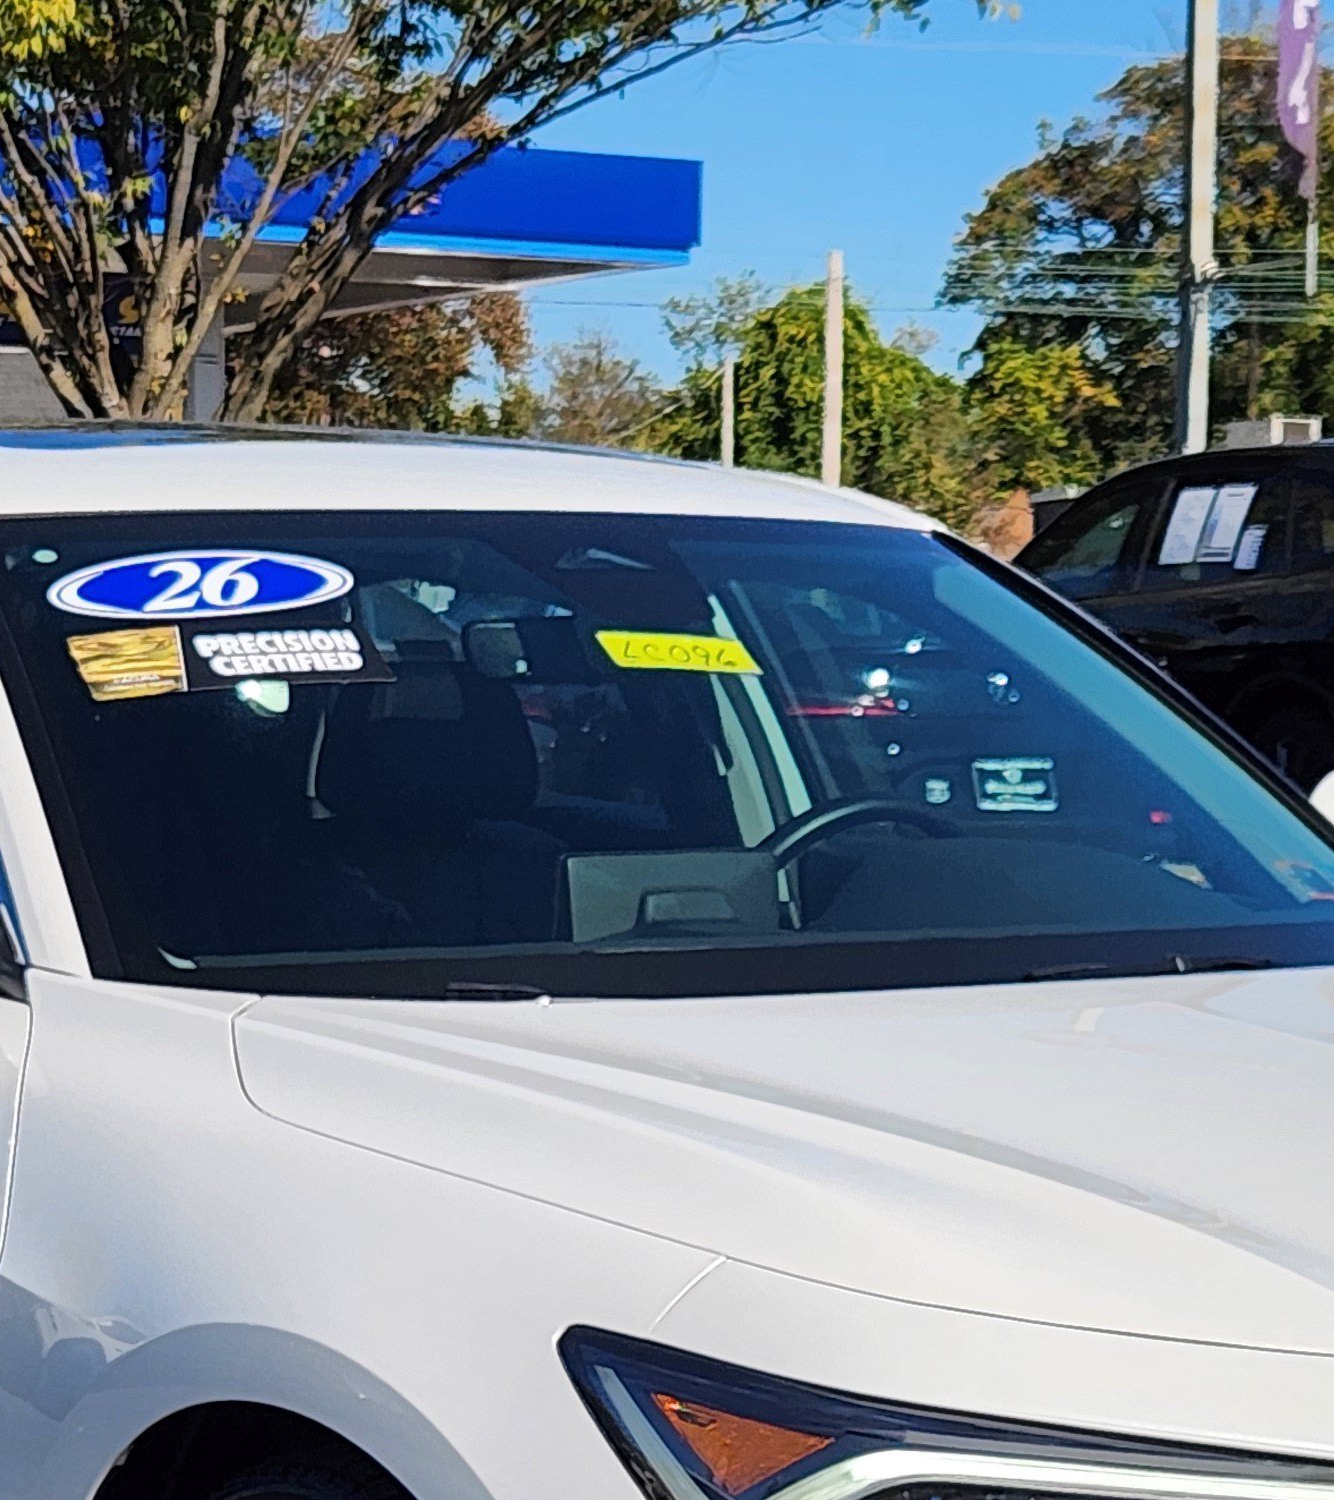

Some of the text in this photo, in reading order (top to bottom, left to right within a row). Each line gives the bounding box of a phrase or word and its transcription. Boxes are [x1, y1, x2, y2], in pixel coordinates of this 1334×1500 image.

[141, 557, 261, 613] 26
[192, 629, 361, 658] PRECISION
[208, 651, 363, 676] CERTIFIED
